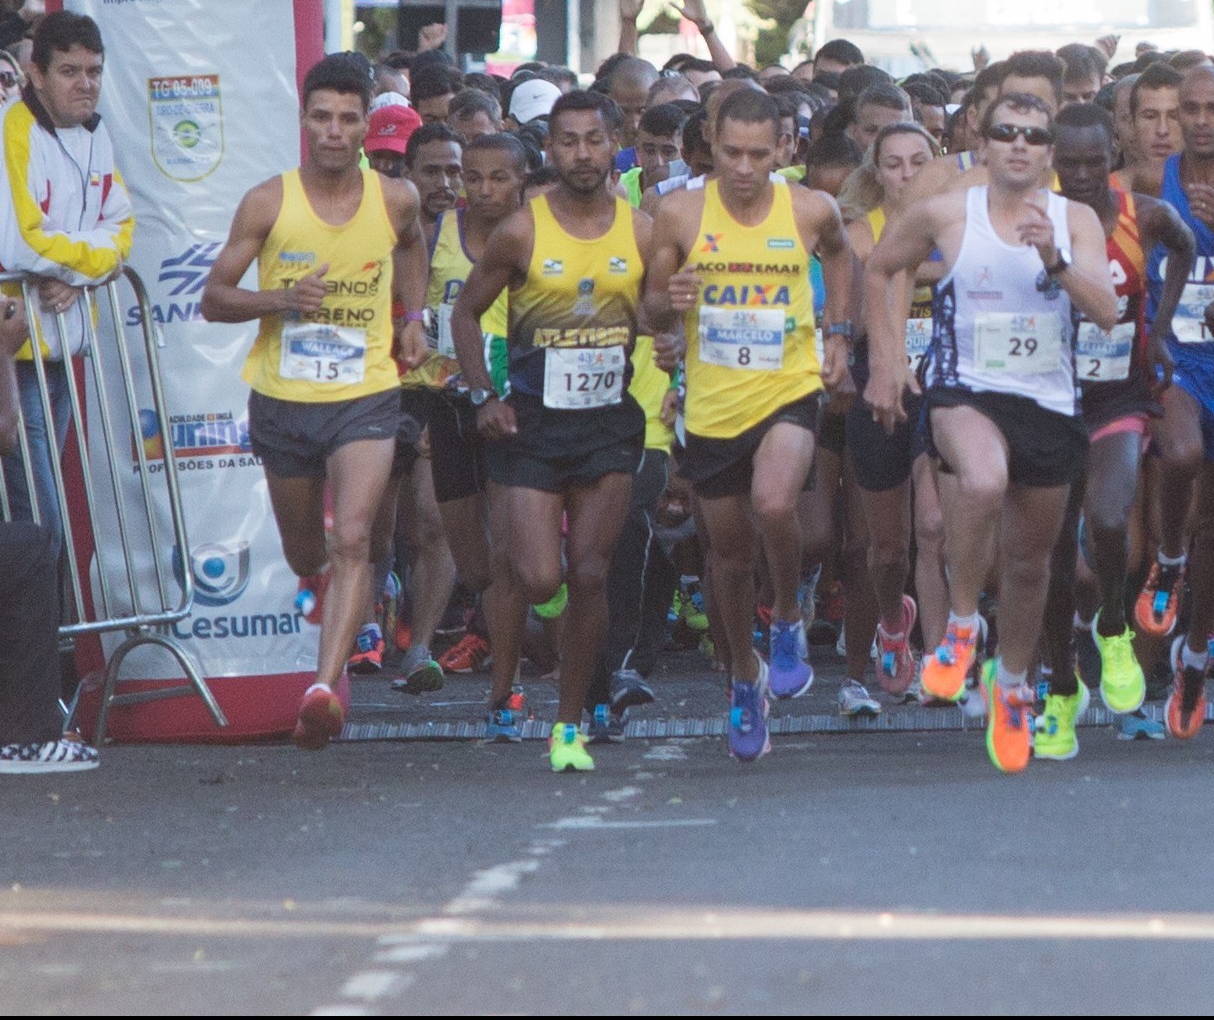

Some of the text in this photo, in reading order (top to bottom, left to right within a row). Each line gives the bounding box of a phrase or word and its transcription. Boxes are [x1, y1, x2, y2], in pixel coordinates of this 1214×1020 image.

[703, 284, 791, 306] CAIXA
[738, 346, 750, 366] 8
[1008, 337, 1038, 356] 29
[315, 360, 339, 380] 15
[1088, 358, 1101, 377] 2
[563, 371, 616, 392] 1270
[218, 458, 236, 469] DA
